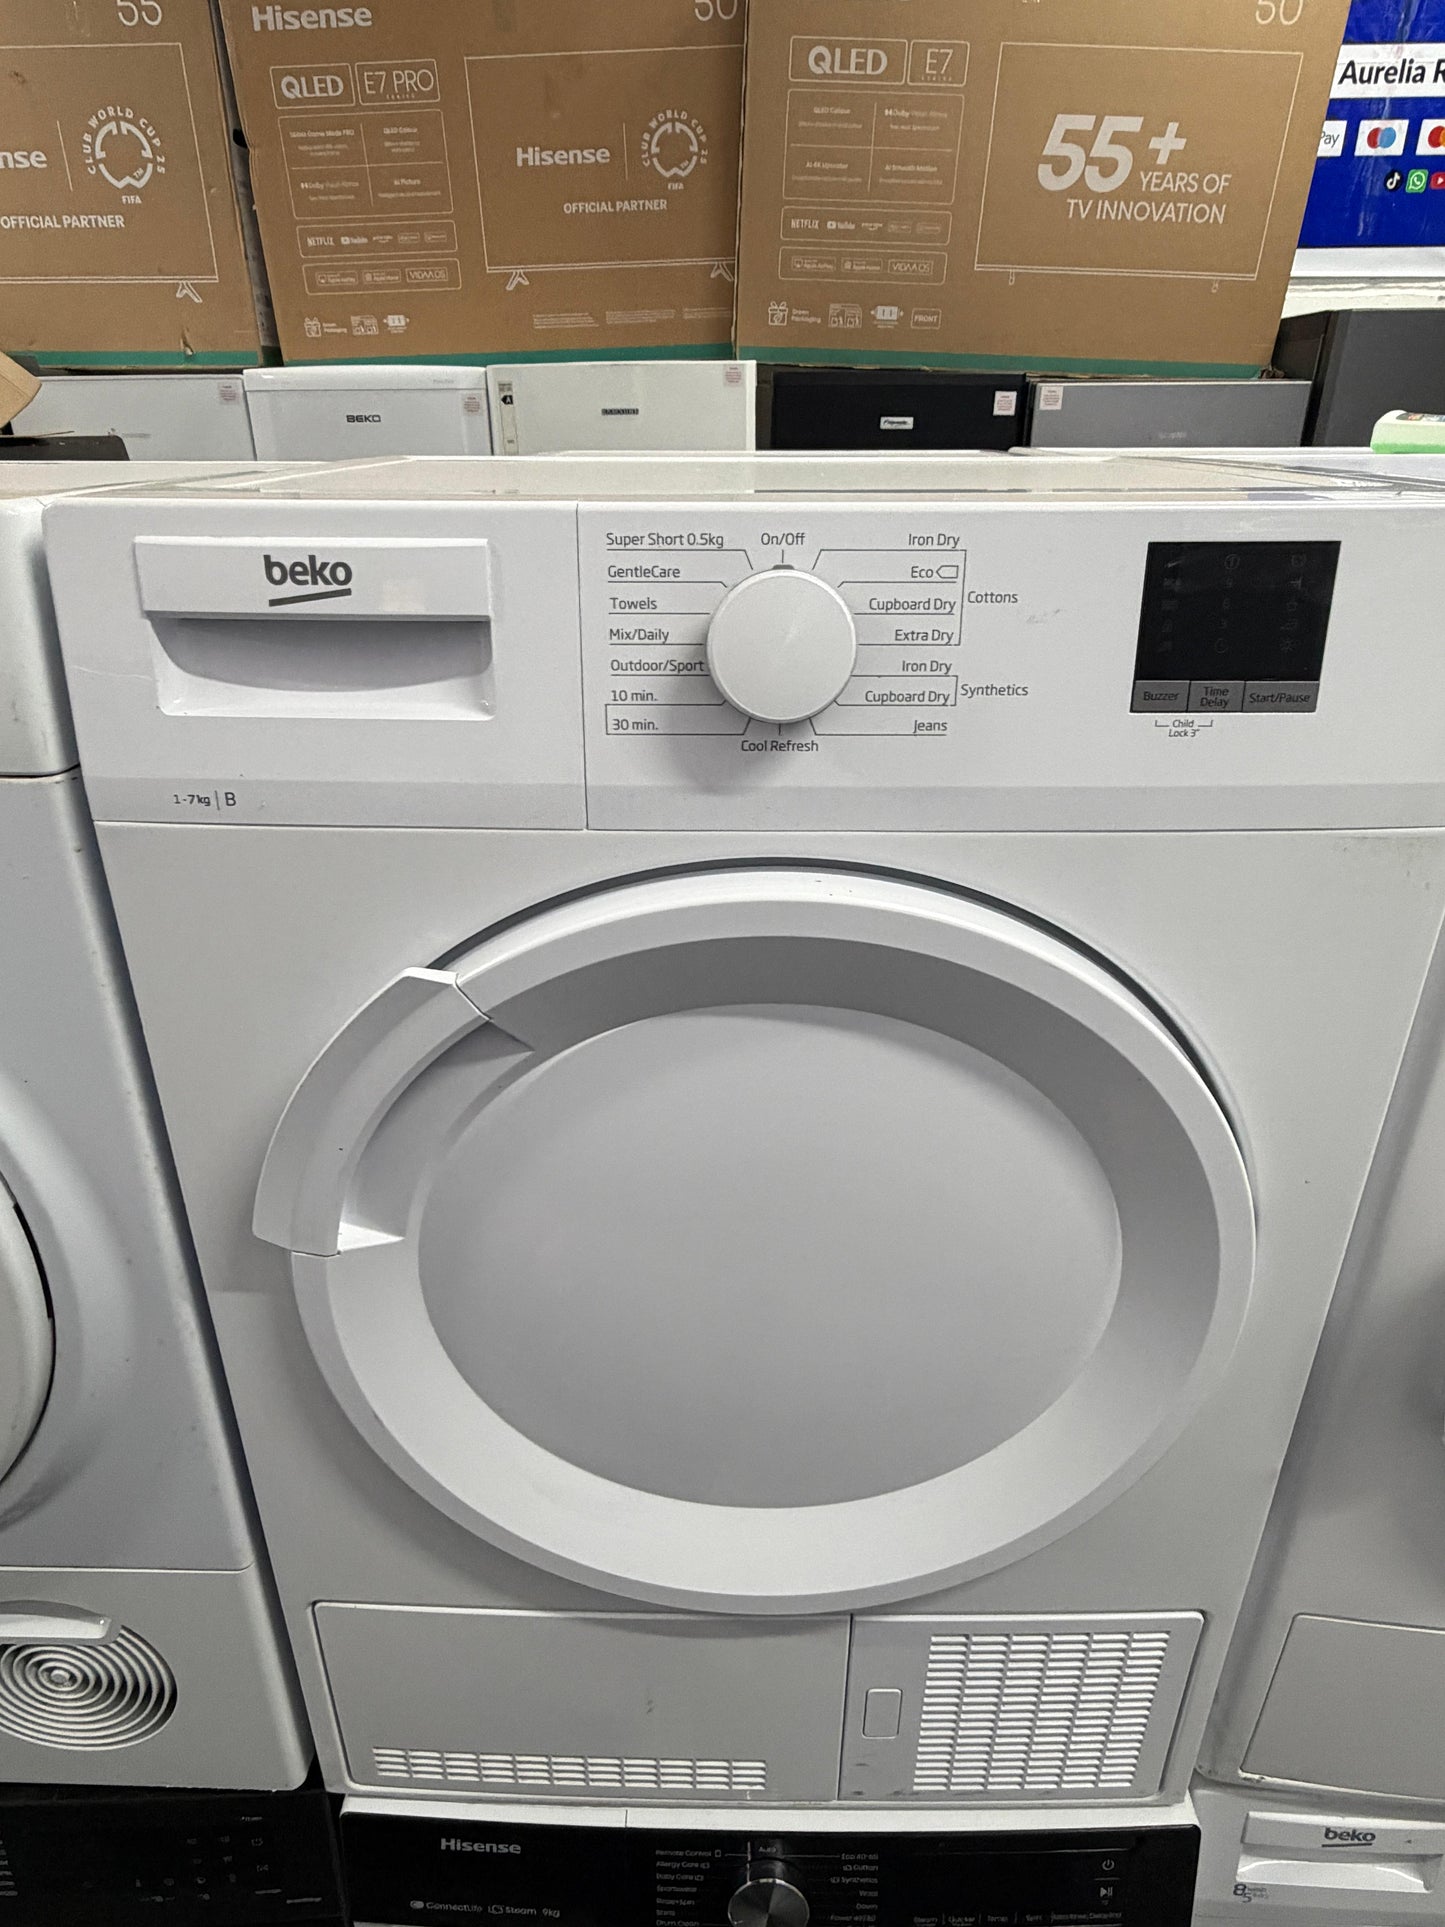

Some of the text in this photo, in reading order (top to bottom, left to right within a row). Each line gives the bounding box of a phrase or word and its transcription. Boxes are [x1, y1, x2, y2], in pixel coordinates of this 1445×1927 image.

[252, 5, 372, 31] Hisense
[808, 45, 888, 75] QLED
[925, 48, 954, 74] E7
[1338, 58, 1426, 85] Aurelia
[281, 75, 344, 99] QLED
[364, 69, 434, 94] E7 PRO
[82, 105, 165, 175] CLUB WORLD CUP 25
[641, 132, 651, 167] CLUB
[648, 109, 688, 129] WORLD
[691, 119, 707, 143] CUP
[516, 147, 611, 167] Hisense
[1140, 171, 1232, 194] YEARS OF
[121, 195, 142, 204] FIFA
[563, 199, 668, 214] OFFICIAL PARTNER
[1067, 199, 1226, 225] TV INNOVATION
[0, 215, 125, 229] OFFICIAL PARTNER
[791, 219, 819, 230] NETFLIX
[914, 315, 938, 323] FRONT
[346, 414, 381, 423] BEKO
[606, 533, 724, 548] Super Short 0.5kg
[761, 533, 806, 546] On/Off
[908, 533, 960, 549] Iron Dry
[263, 554, 352, 586] beko
[608, 565, 681, 578] GentleCare
[911, 566, 934, 578] Eco
[610, 597, 658, 610] Towels
[967, 591, 1018, 604] Cottons
[869, 598, 956, 614] Cupboard Dry
[609, 628, 669, 644] Mix/Daily
[895, 629, 954, 645] Extra Dry
[611, 659, 704, 673] Outdoor/Sport
[902, 660, 952, 675] Iron Dry
[611, 690, 658, 701] 10 min.
[865, 691, 950, 706] Cupboard Dry
[960, 684, 1029, 698] Synthetics
[1143, 691, 1180, 701] Buzzer
[1203, 686, 1229, 696] Time
[1249, 692, 1311, 704] Start/Pause
[1200, 697, 1229, 708] Delay
[612, 718, 659, 731] 30 min.
[913, 719, 948, 734] Jeans
[1172, 719, 1194, 728] Child
[1169, 729, 1188, 737] Lock
[741, 740, 819, 752] Cool Refresh
[173, 792, 237, 807] 1-7kg B
[1324, 1827, 1376, 1843] beko
[440, 1838, 521, 1854] Hisense
[1233, 1883, 1246, 1896] 8
[542, 1908, 561, 1918] 9kg
